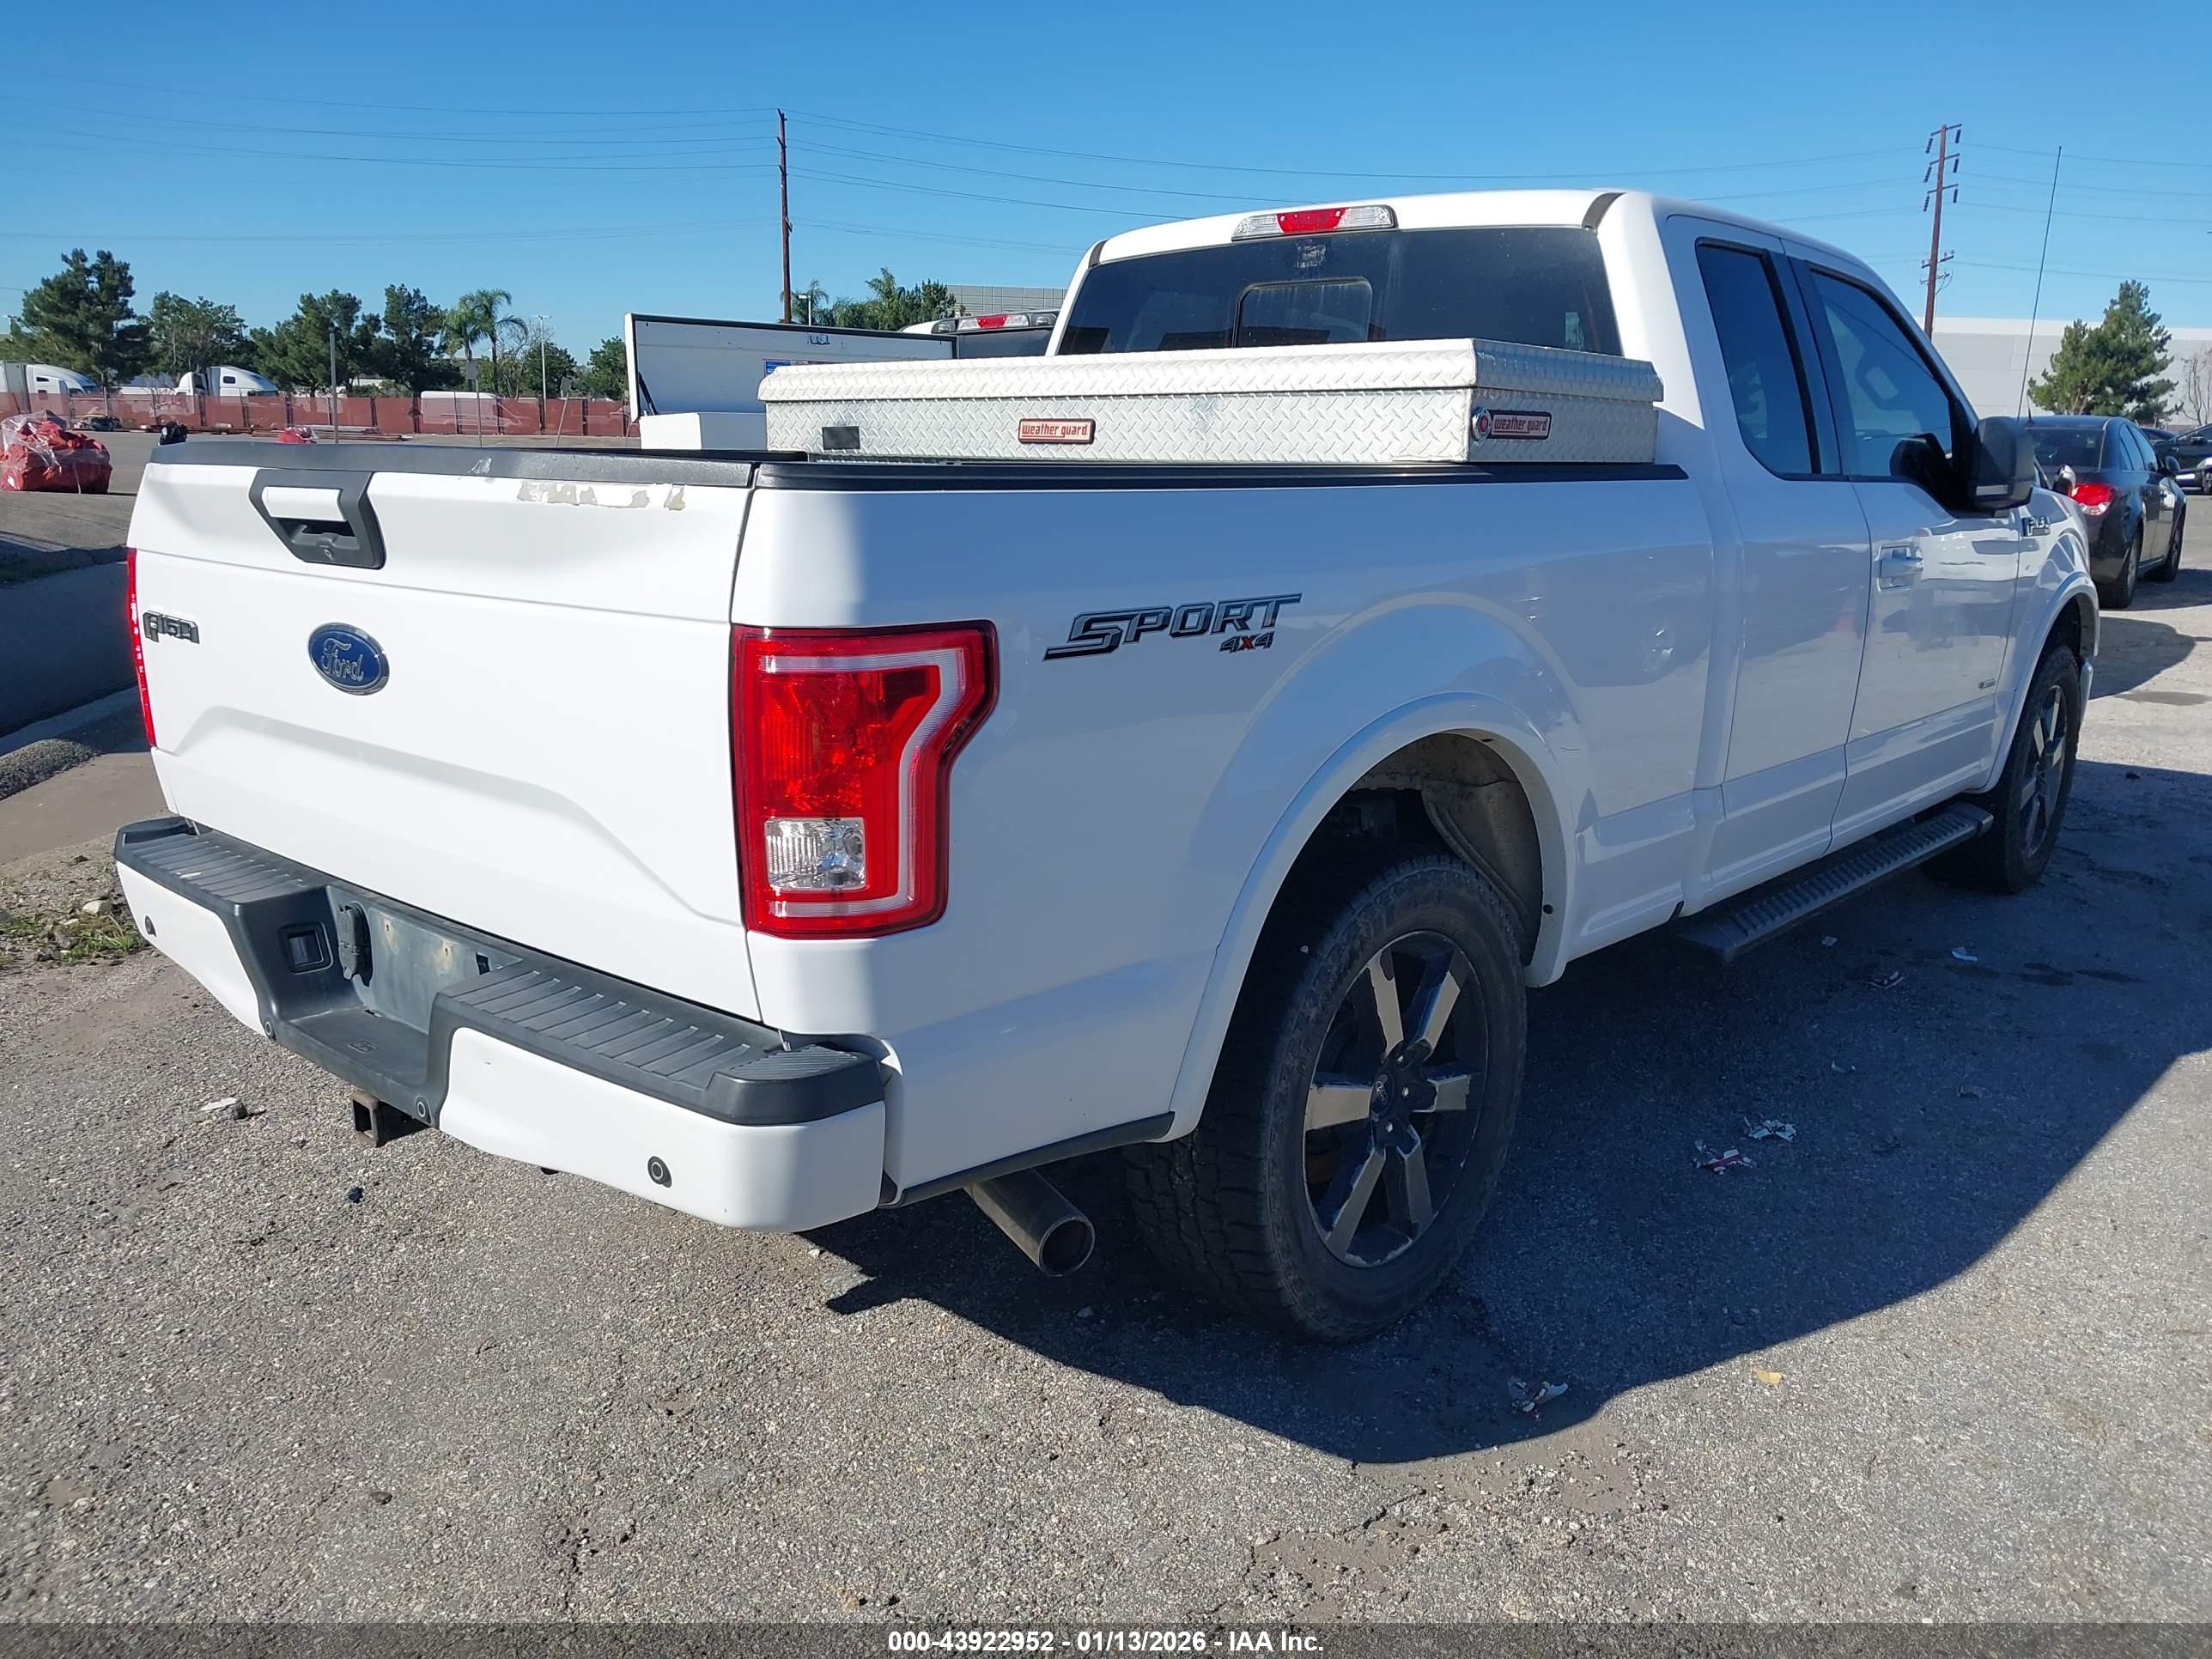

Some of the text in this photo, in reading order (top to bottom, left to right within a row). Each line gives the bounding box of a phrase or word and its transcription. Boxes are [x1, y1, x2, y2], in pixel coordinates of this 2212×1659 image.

[1022, 423, 1088, 437] weather guard
[1494, 416, 1548, 433] weather guard
[1042, 592, 1303, 662] SPORT
[321, 638, 364, 681] Ford
